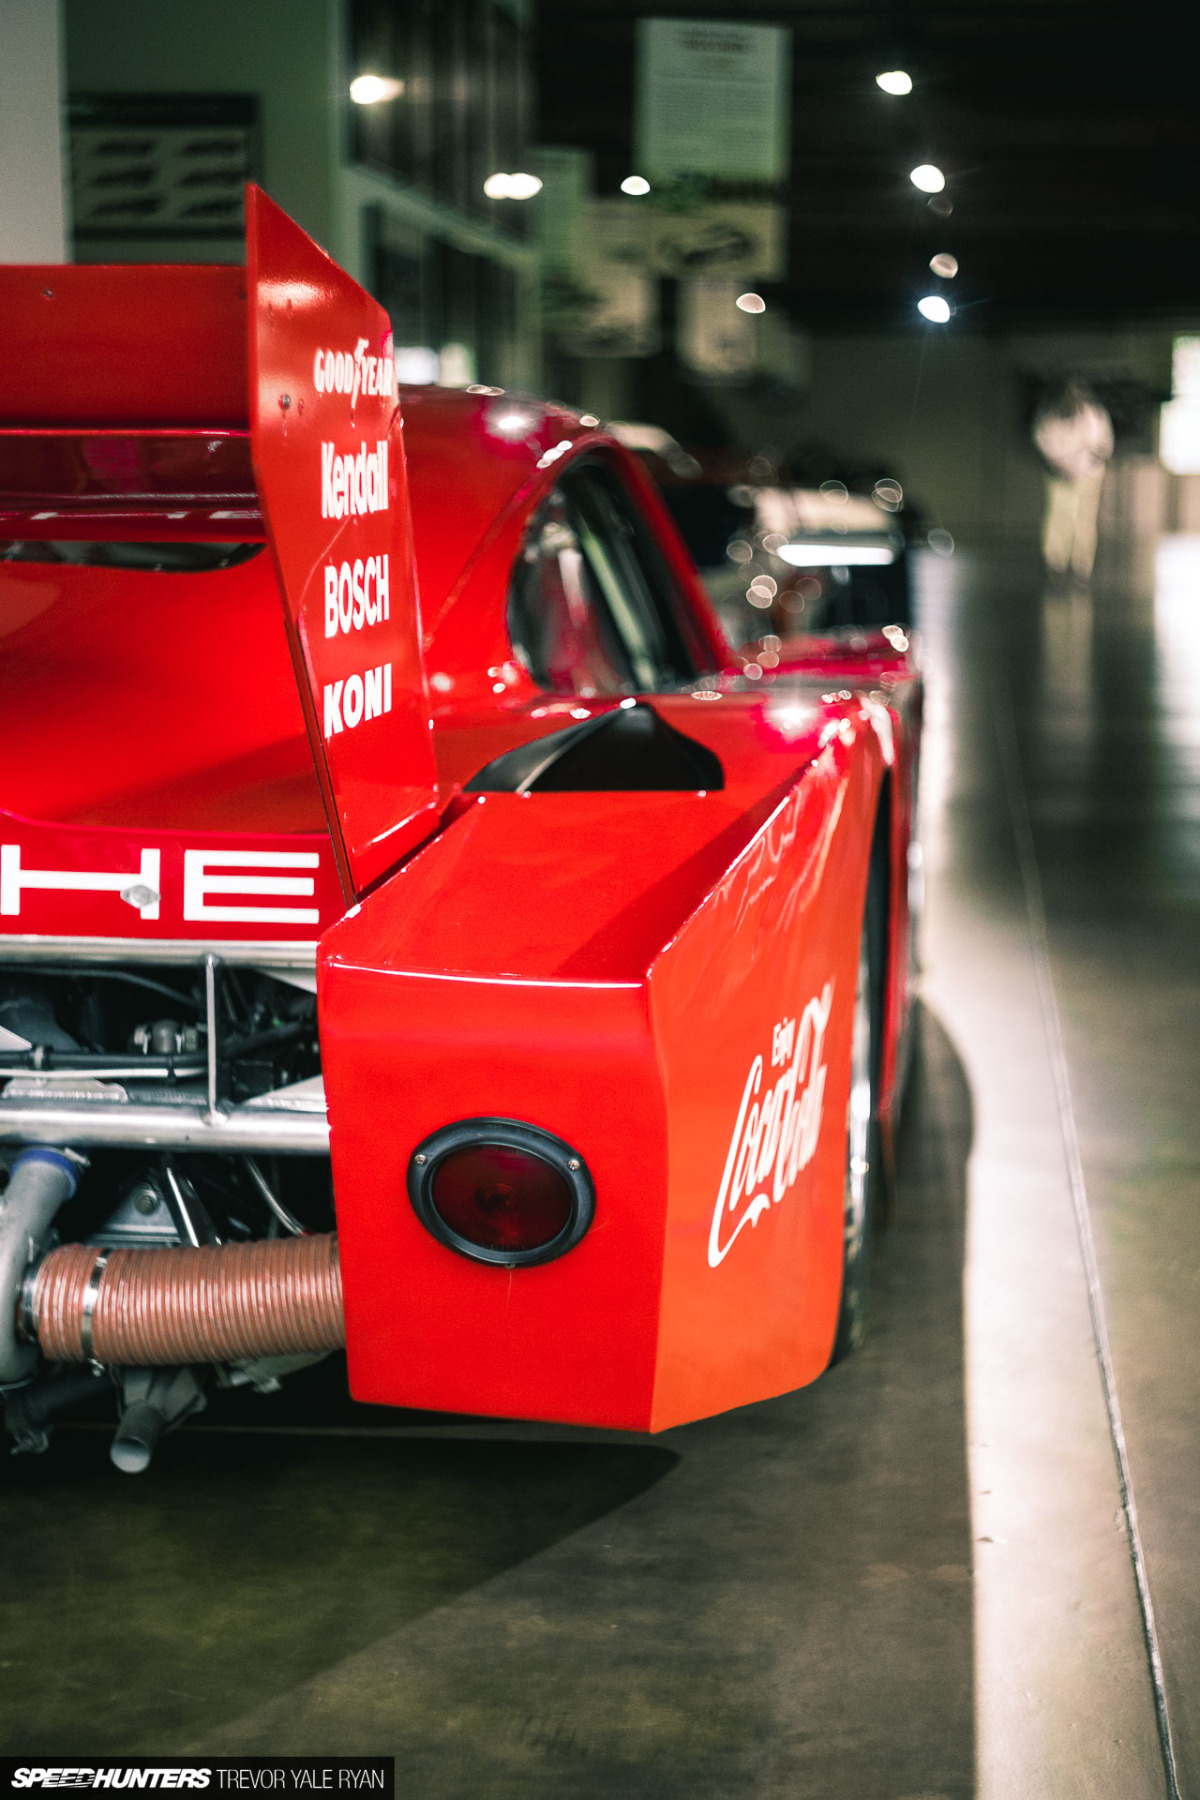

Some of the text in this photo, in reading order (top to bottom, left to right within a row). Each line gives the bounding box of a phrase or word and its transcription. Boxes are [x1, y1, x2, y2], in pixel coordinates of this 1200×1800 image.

[314, 337, 393, 408] GOODYEAR
[321, 440, 389, 519] Kendall
[324, 554, 390, 639] BOSCH
[323, 663, 392, 739] KONI
